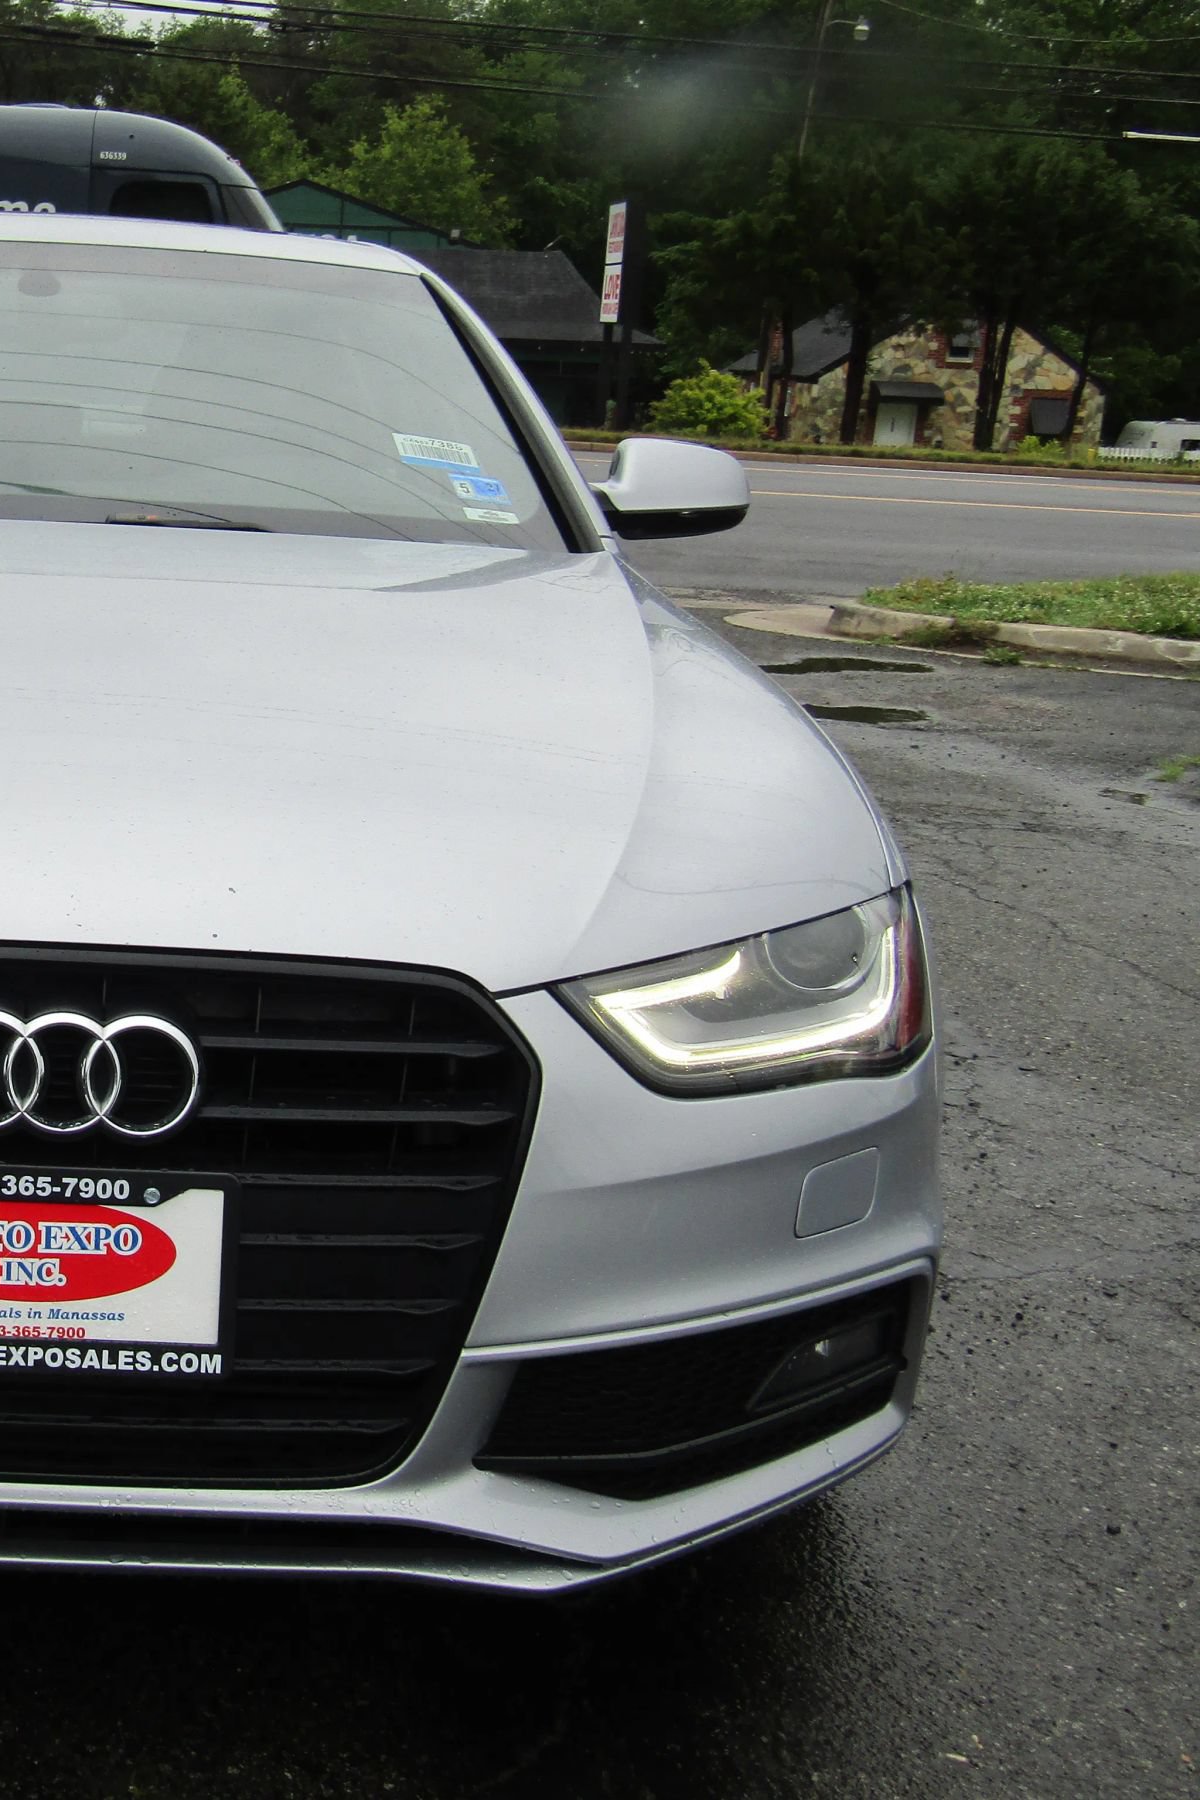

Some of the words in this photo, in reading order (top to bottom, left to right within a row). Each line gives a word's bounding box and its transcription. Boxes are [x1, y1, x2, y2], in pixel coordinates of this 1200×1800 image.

[460, 483, 470, 494] 5
[38, 1221, 142, 1256] EXPO
[0, 1257, 66, 1286] INC.
[27, 1308, 43, 1320] in
[48, 1309, 125, 1322] Manassas
